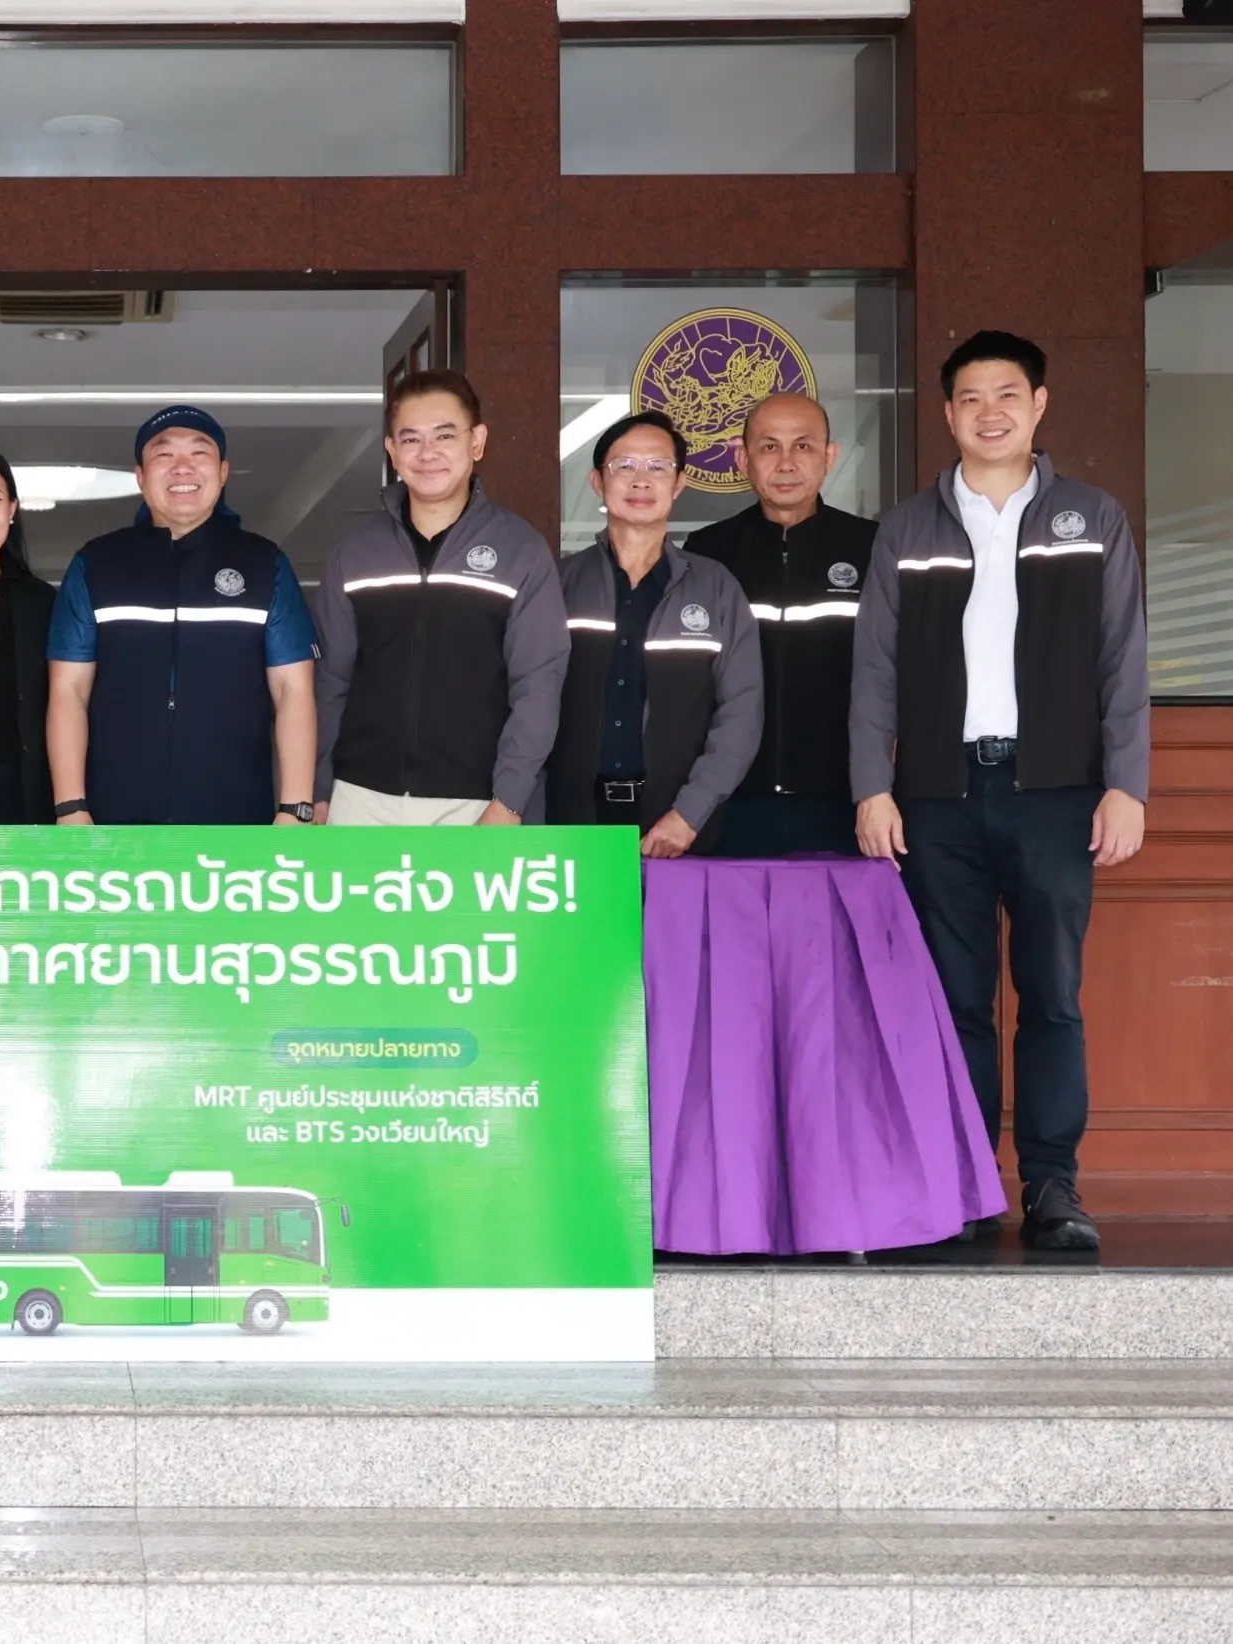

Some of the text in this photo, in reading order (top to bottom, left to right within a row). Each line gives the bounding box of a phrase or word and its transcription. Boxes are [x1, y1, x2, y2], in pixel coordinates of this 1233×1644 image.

[474, 854, 578, 913] ฟรี!
[287, 1038, 461, 1063] จุดหมายปลายทาง
[193, 1085, 252, 1107] MRT
[246, 1117, 490, 1148] และ BTS วงเวียนใหญ่
